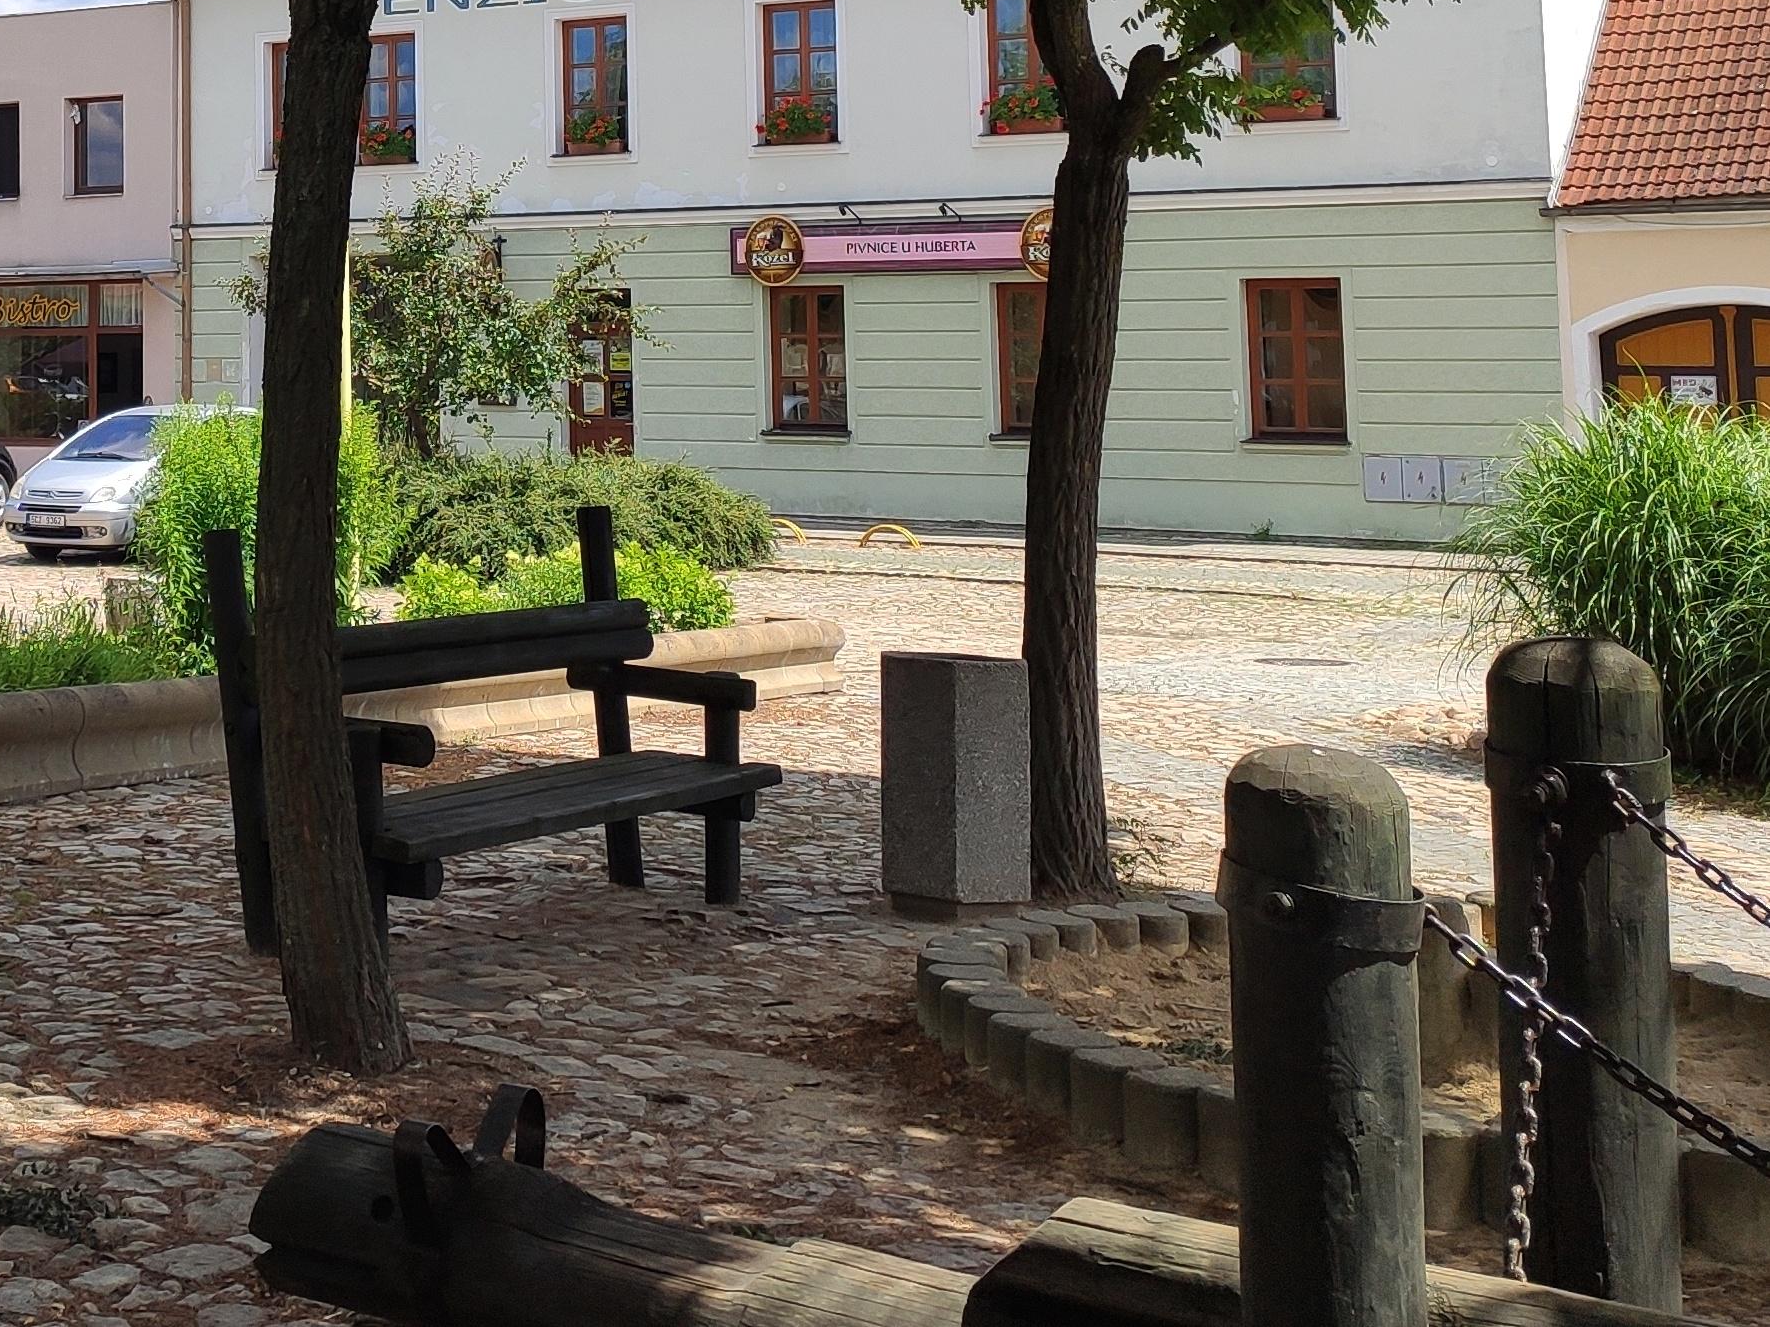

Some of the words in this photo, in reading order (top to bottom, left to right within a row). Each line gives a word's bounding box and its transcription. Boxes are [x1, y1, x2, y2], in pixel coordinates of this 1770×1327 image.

[846, 242, 898, 254] PIVNICE
[902, 241, 911, 253] U
[915, 240, 976, 253] HUBERTA
[752, 251, 797, 267] Kozel
